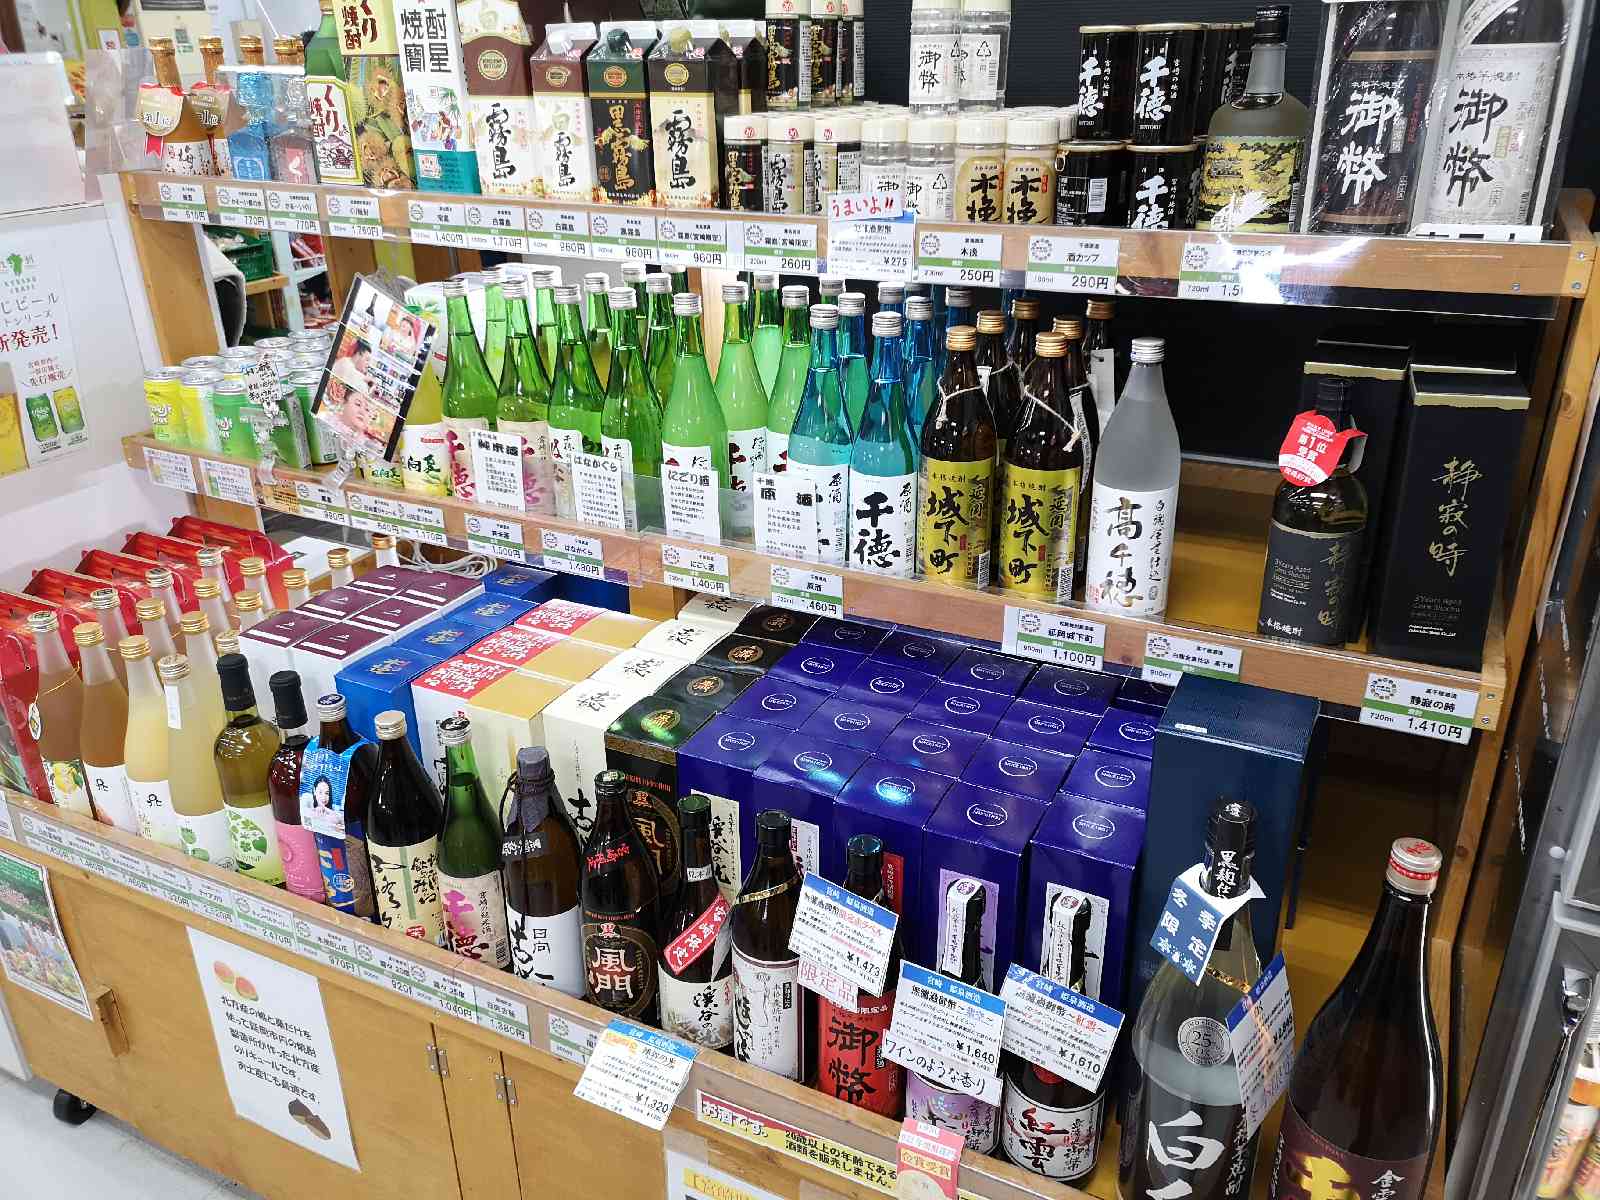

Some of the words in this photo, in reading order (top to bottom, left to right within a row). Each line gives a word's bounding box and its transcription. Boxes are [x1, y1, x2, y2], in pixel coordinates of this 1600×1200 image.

[341, 5, 363, 50] 焼酎
[399, 8, 448, 40] 焼酎
[1135, 55, 1172, 121] 千徳
[664, 109, 697, 190] 霧島
[1338, 90, 1404, 206] 御幣
[1443, 88, 1509, 207] 御幣
[693, 252, 722, 265] 960円
[781, 257, 812, 271] 260円
[1066, 253, 1099, 264] 酒カップ
[960, 270, 995, 284] 250円
[1071, 275, 1109, 290] 290円
[668, 469, 710, 487] にごり酒
[853, 491, 901, 570] 千徳
[925, 485, 970, 575] 城下町
[1428, 456, 1485, 577] 静寂の時
[1006, 493, 1049, 585] 城下町
[1099, 496, 1145, 609] 高千穂
[1047, 628, 1095, 644] 延岡城下町
[1266, 617, 1305, 637] 本格焼酎
[1369, 712, 1395, 723] 720ml
[1409, 695, 1456, 713] 静寂の時
[1406, 717, 1463, 740] 1,410円
[533, 928, 551, 955] 日向
[846, 951, 881, 978] ¥1,473
[799, 959, 857, 1004] 限定品
[956, 1039, 996, 1064] ¥1,640
[1191, 1030, 1212, 1048] 25
[827, 1018, 880, 1102] 御幣
[885, 1037, 986, 1096] ワインのような香り
[1058, 1046, 1102, 1075] ¥1,610
[635, 1090, 670, 1115] ¥1,320
[784, 1129, 897, 1181] 20歳以上の年齢である
[1017, 1106, 1072, 1175] 紅雲
[784, 1139, 894, 1190] 酒類を販売しません。
